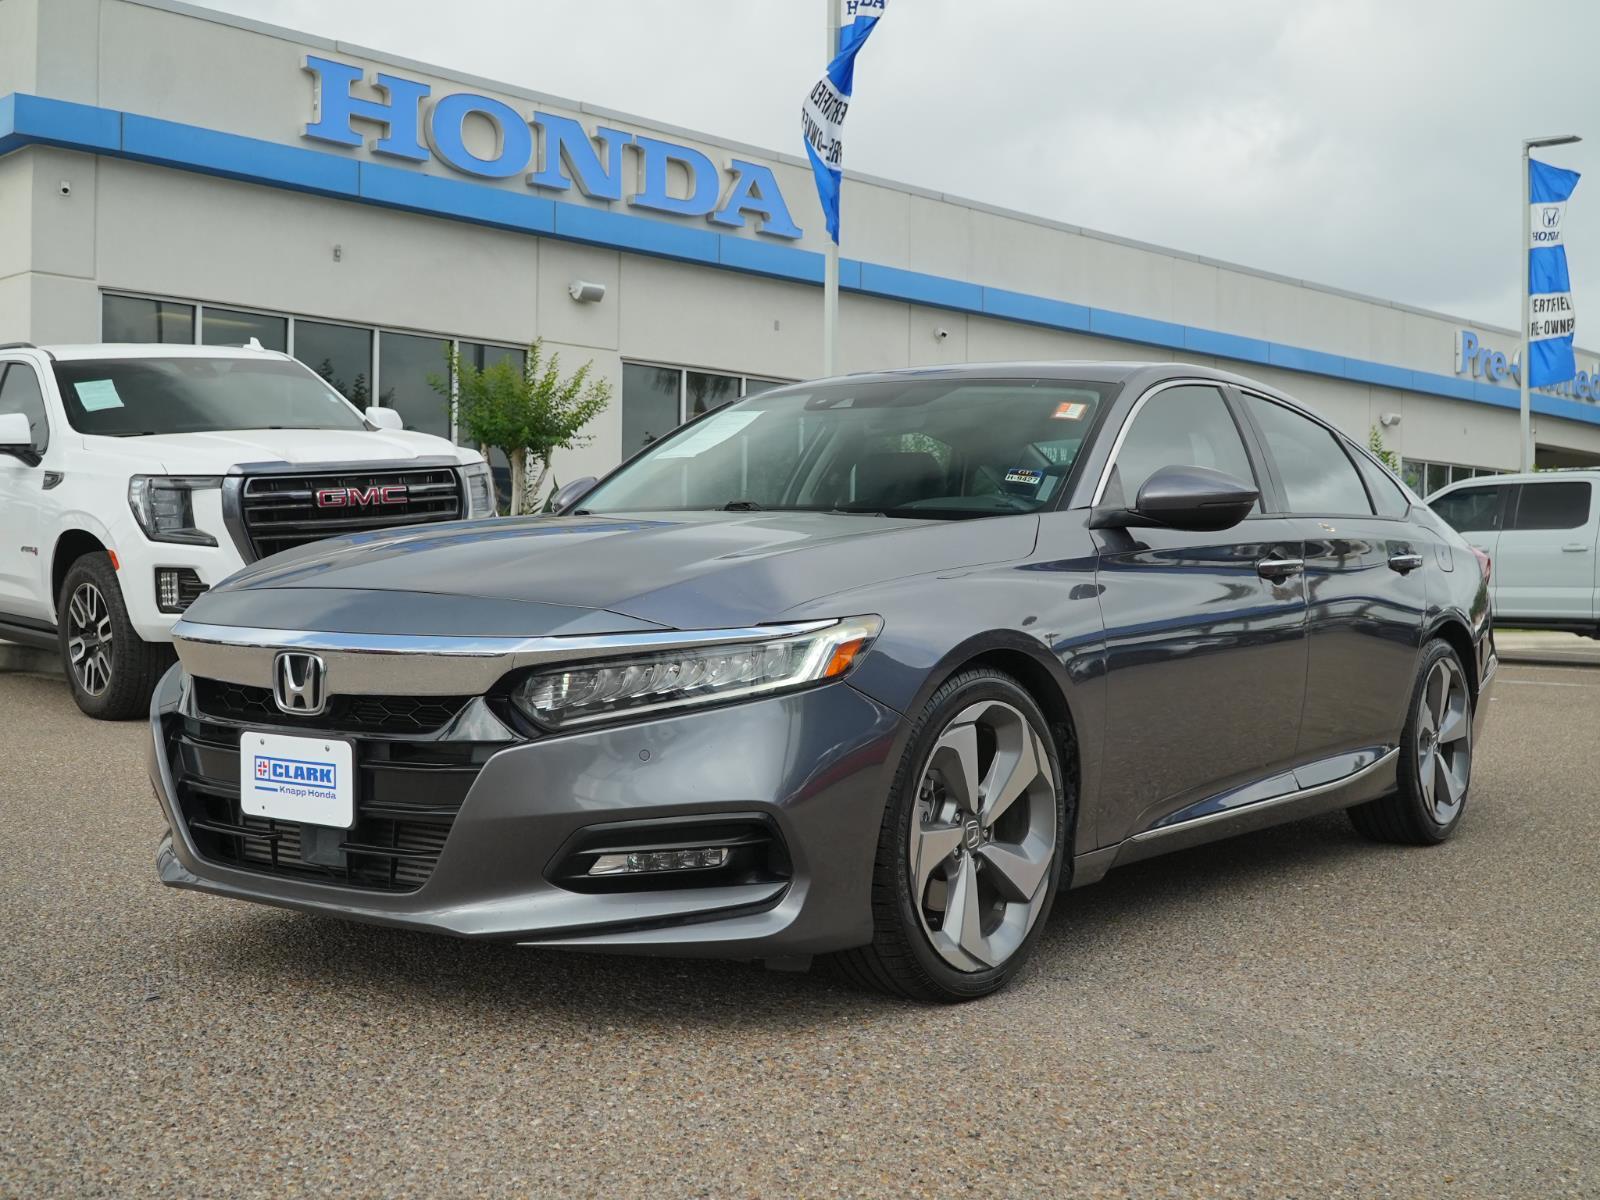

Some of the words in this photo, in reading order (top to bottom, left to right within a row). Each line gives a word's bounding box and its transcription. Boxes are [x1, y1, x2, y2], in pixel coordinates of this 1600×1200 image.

[302, 54, 803, 239] HONDA
[316, 485, 408, 508] GMC
[272, 763, 332, 783] CLARK
[279, 786, 306, 797] Knapp
[308, 789, 336, 800] Honda
